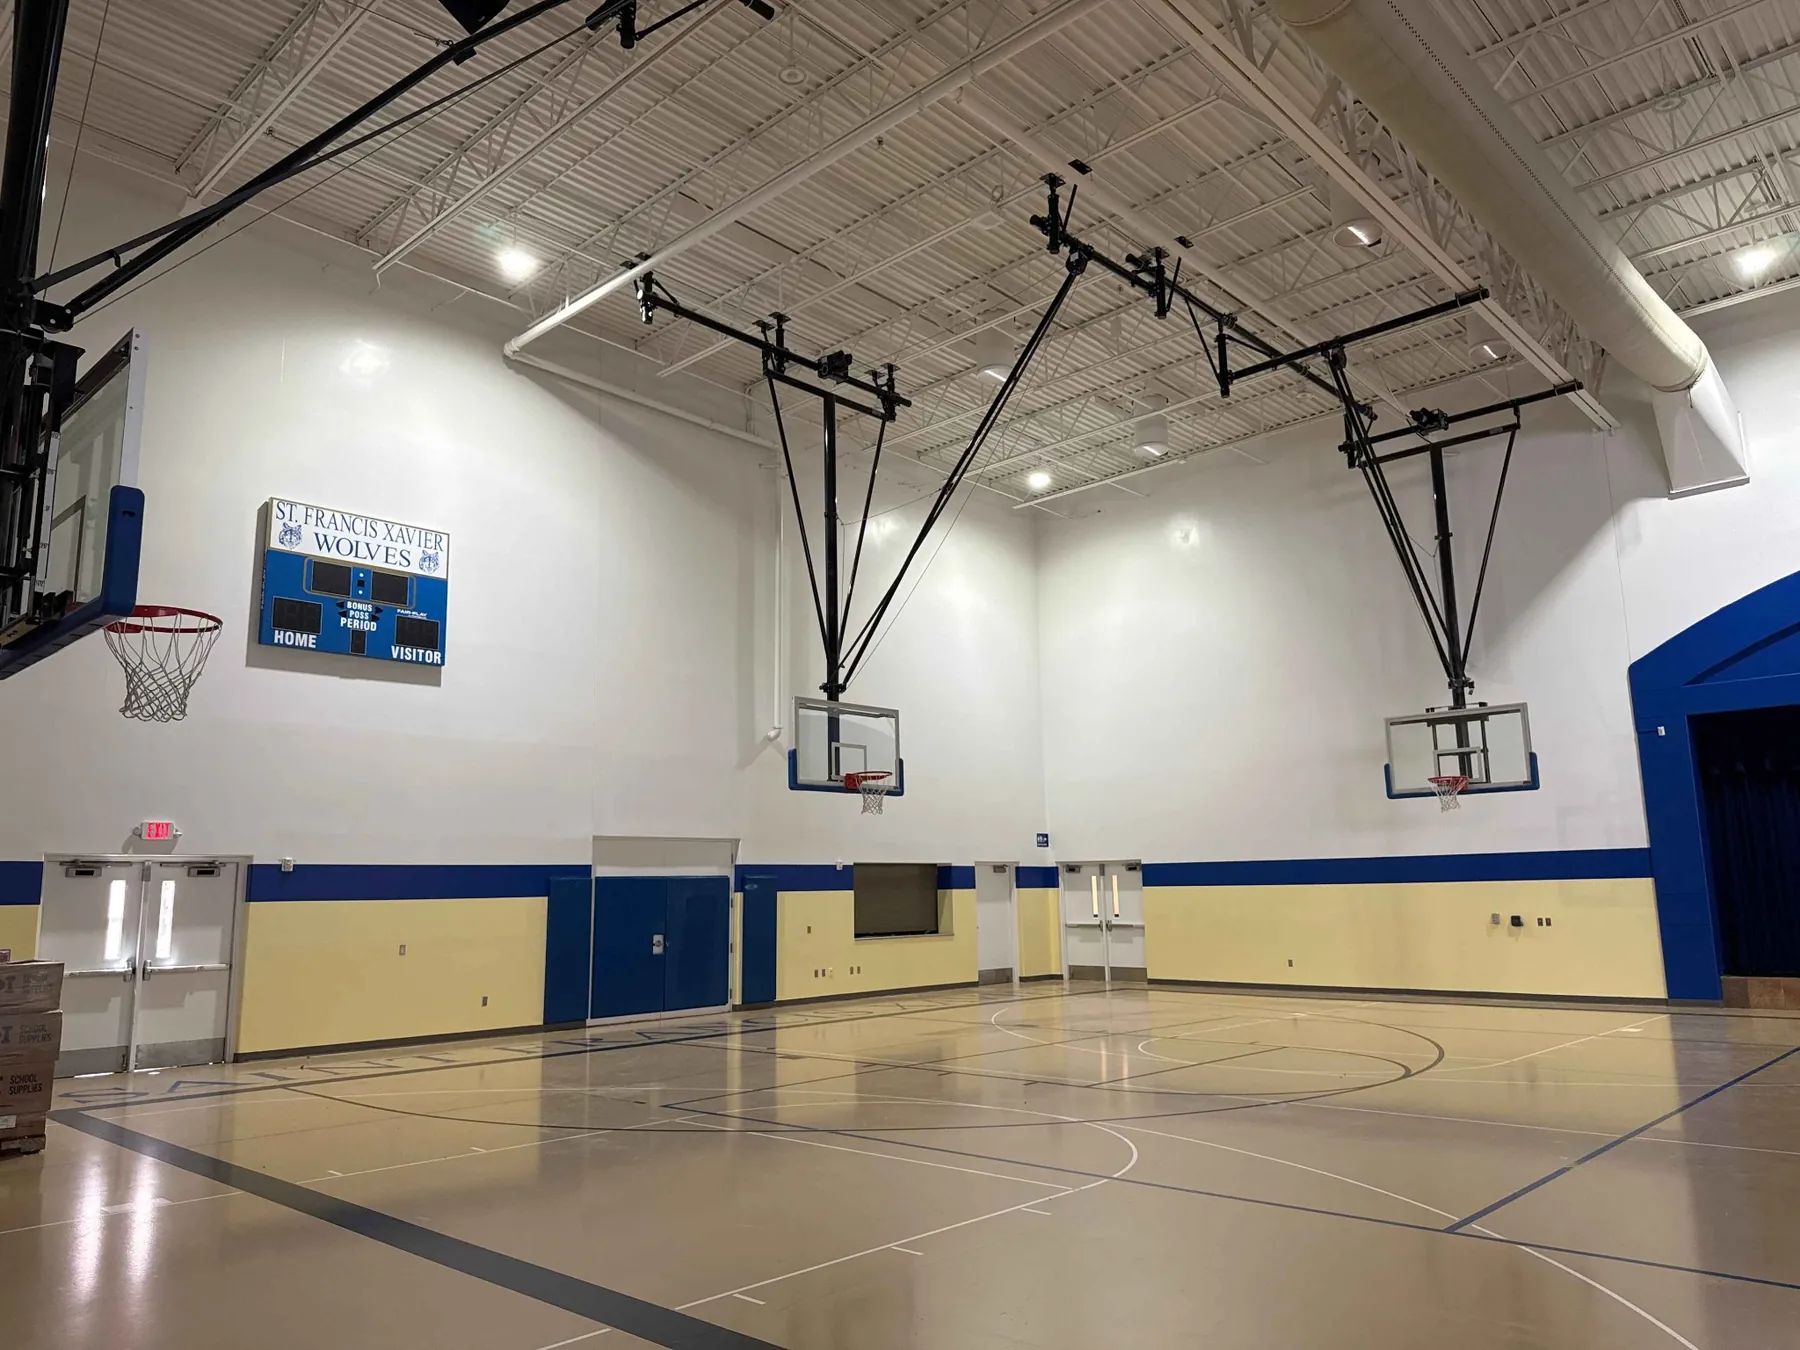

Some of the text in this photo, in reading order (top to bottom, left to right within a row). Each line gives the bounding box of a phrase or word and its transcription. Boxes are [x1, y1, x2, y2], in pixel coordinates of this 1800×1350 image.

[276, 501, 445, 551] ST. FRANCIS XAVIER
[313, 532, 411, 568] WOLVES
[347, 601, 373, 612] BONUS
[349, 610, 369, 620] POSS
[340, 617, 377, 631] PERIOD
[274, 629, 317, 648] HOME
[391, 645, 442, 664] VISITOR
[9, 1073, 37, 1085] SCHOOL
[57, 1052, 463, 1104] SAINT
[9, 1083, 43, 1095] SUPPLIES
